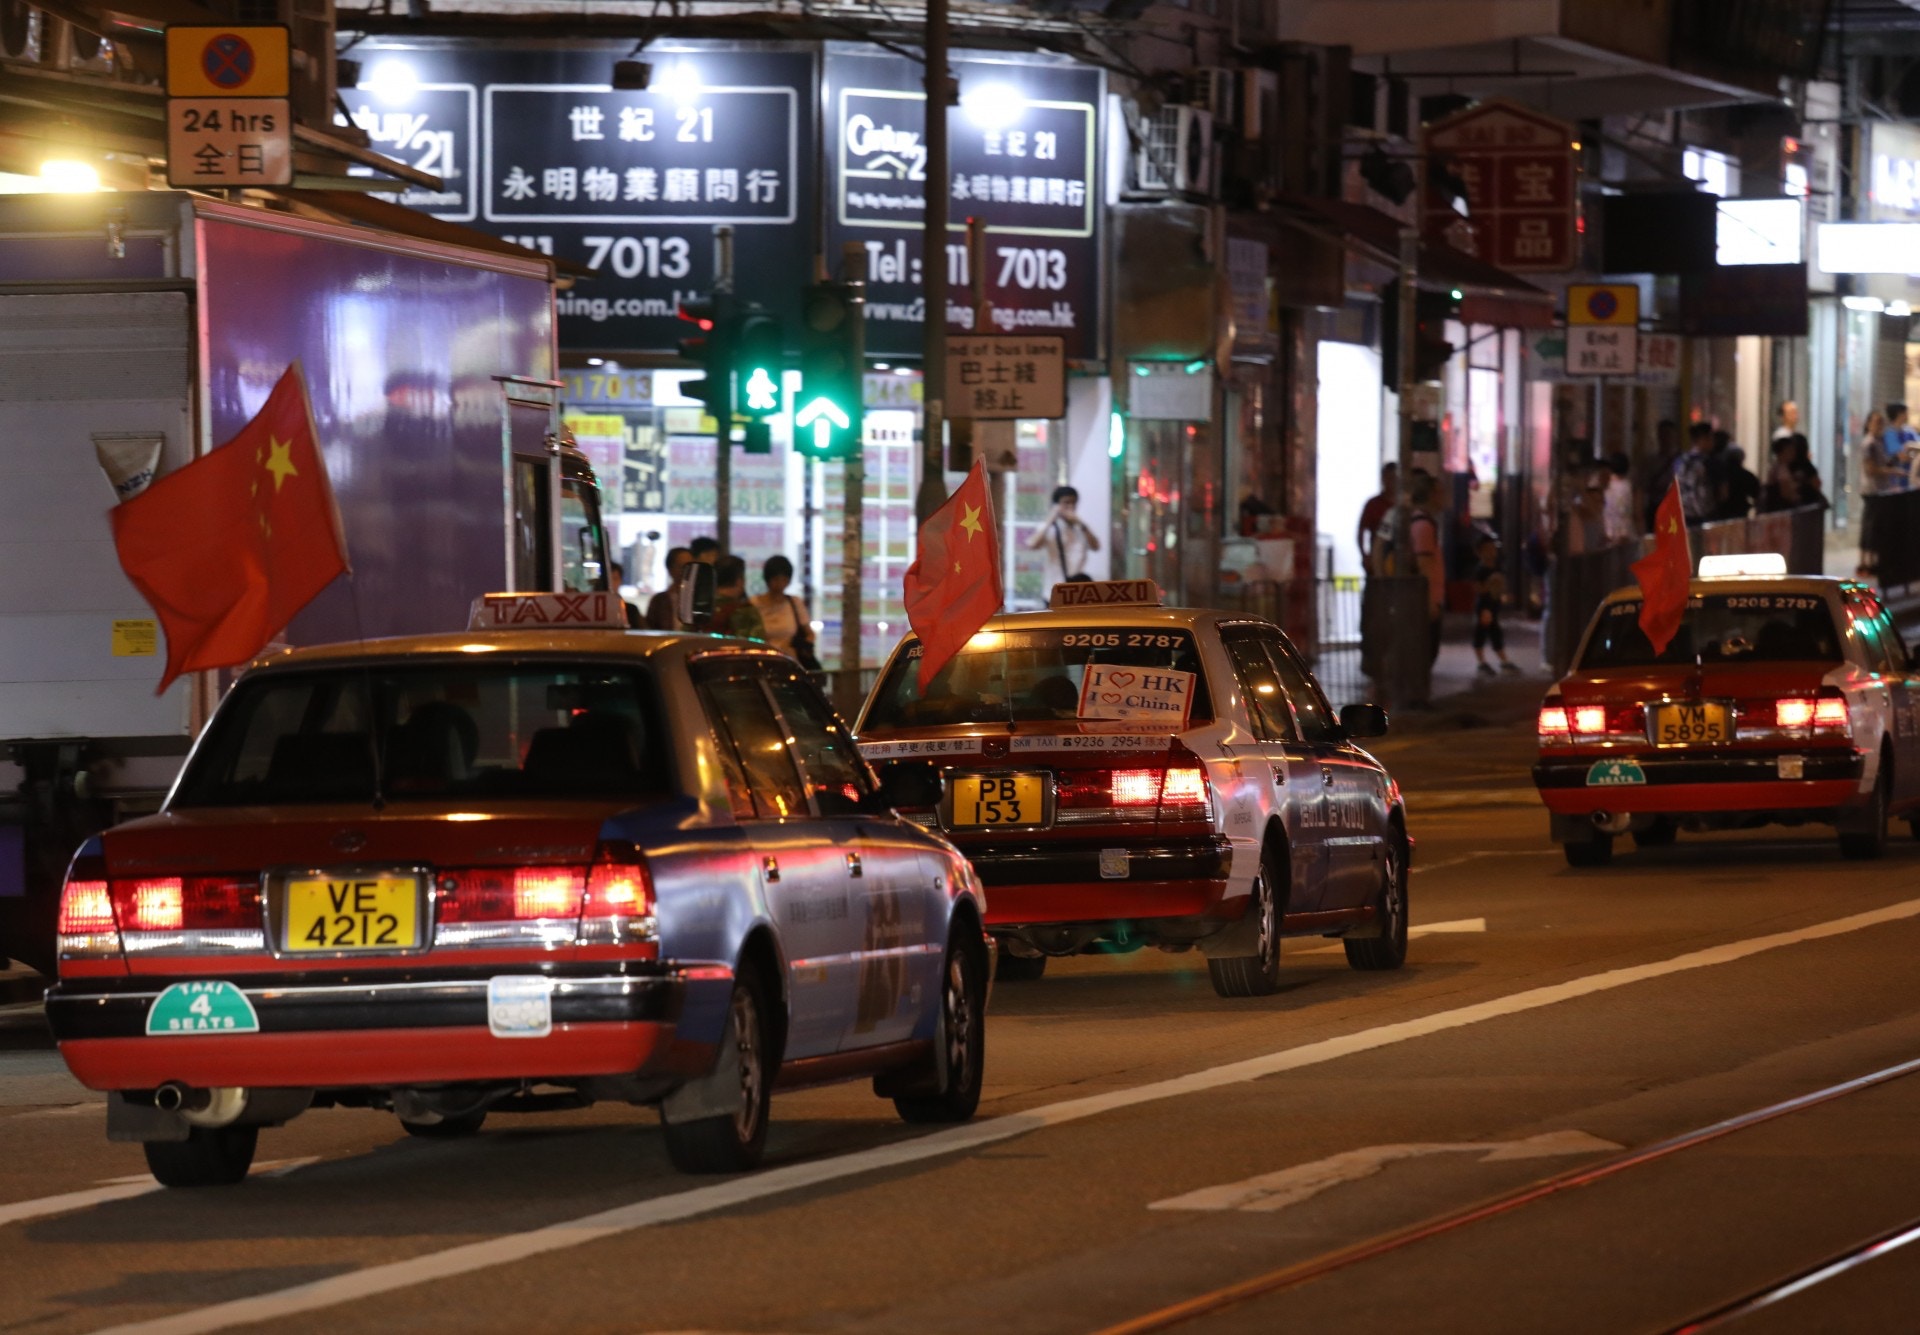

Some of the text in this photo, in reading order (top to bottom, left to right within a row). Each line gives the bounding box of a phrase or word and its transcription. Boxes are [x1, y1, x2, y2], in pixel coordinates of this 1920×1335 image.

[183, 109, 275, 132] 24 hrs
[568, 105, 713, 143] 世紀 21
[194, 143, 264, 175] 全日
[502, 166, 781, 203] 永明物業顧問行
[583, 236, 691, 279] 7013
[996, 248, 1068, 290] 7013
[1057, 582, 1149, 605] TAXI
[1726, 597, 1818, 610] 9205 2787
[483, 594, 608, 624] TAXI
[1062, 633, 1185, 649] 9205 2787
[1094, 672, 1185, 694] I HK
[1125, 695, 1182, 712] China
[1678, 707, 1706, 724] VM
[1036, 738, 1058, 747] TAXI
[1073, 736, 1105, 747] 9236
[1111, 736, 1142, 747] 2954
[1664, 723, 1721, 741] 5895
[980, 778, 1017, 801] PB
[975, 801, 1022, 824] 153
[328, 882, 378, 913] VE
[305, 914, 398, 946] 4212
[179, 982, 225, 995] TAXI
[189, 993, 212, 1017] 4
[169, 1015, 235, 1030] SEATS
